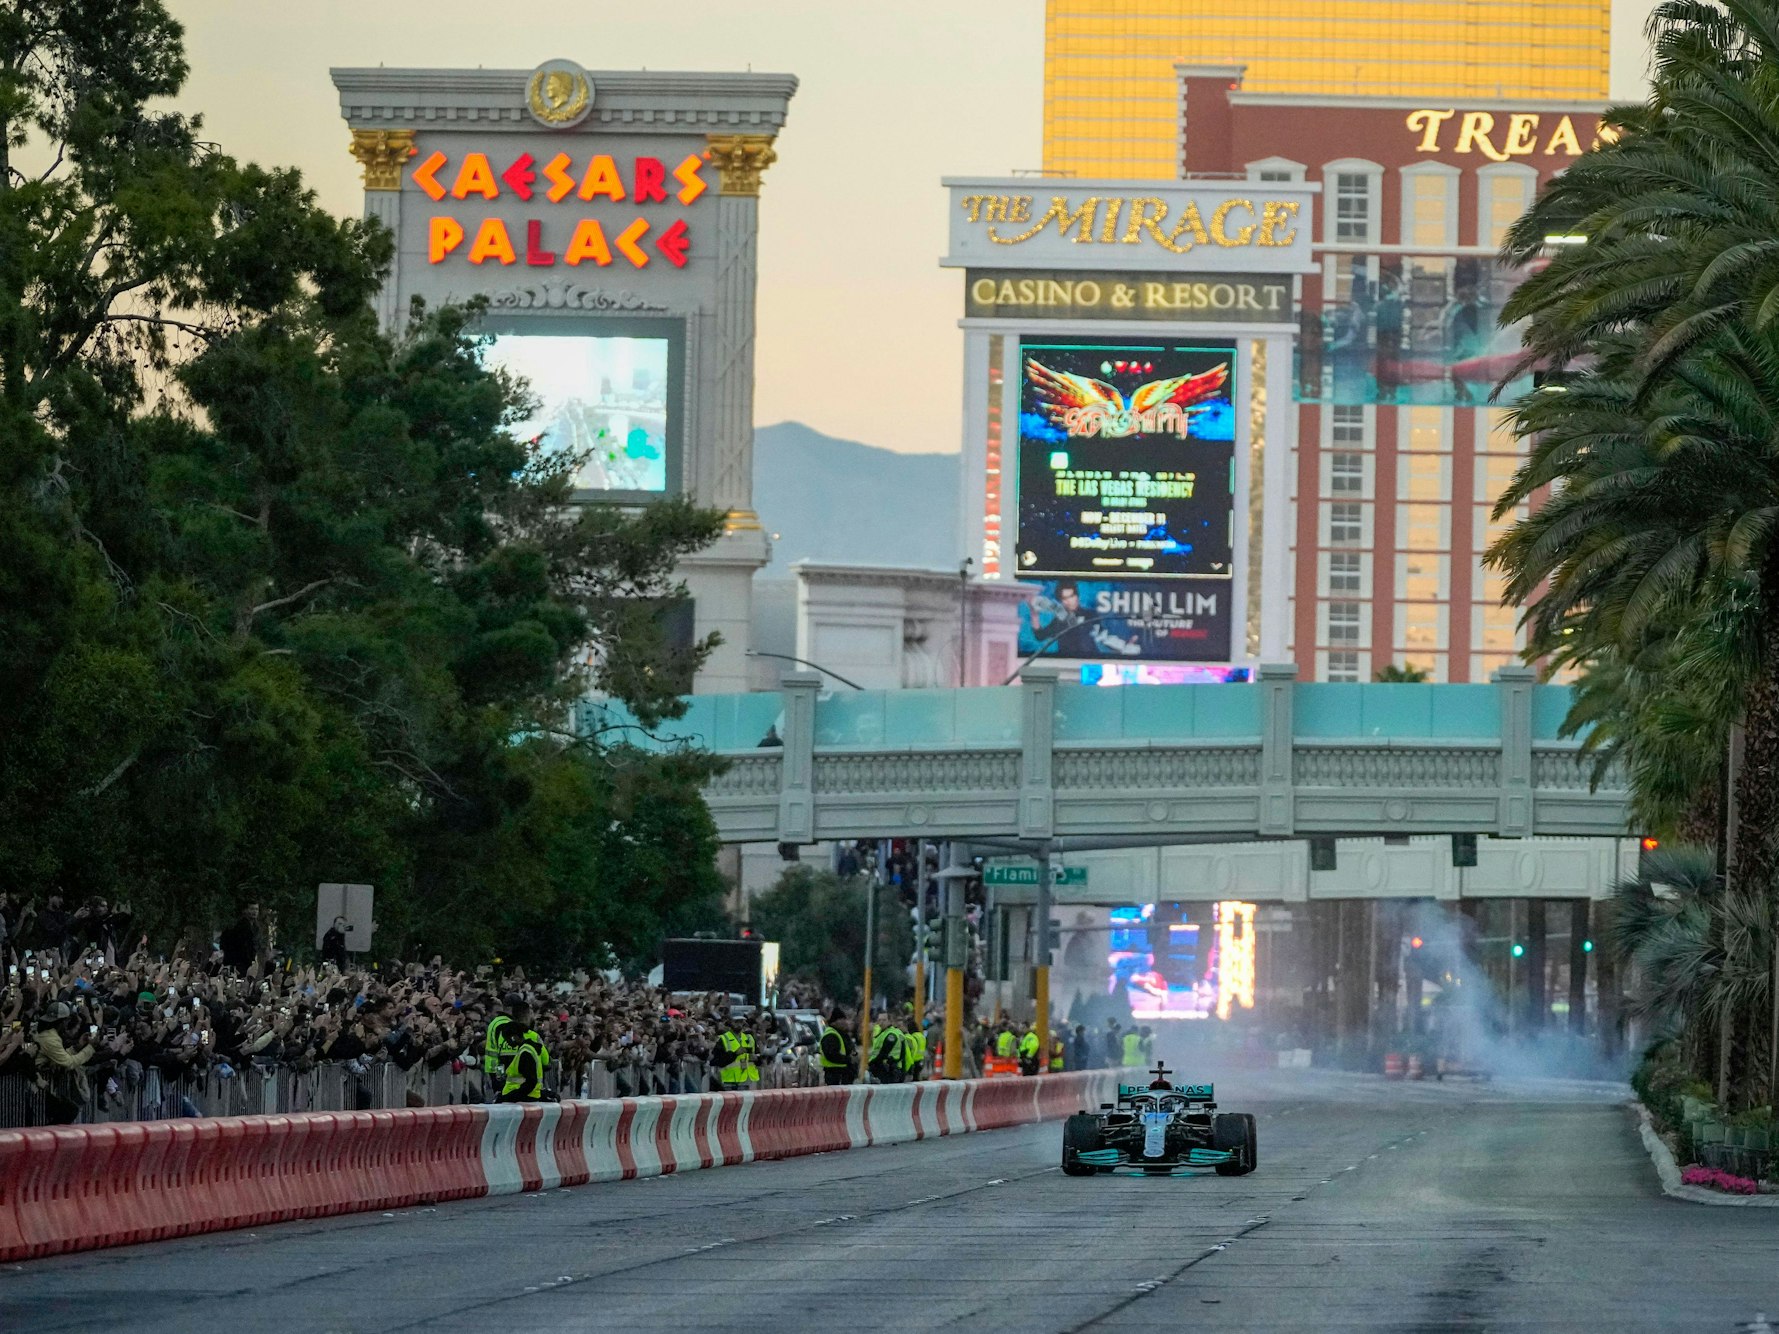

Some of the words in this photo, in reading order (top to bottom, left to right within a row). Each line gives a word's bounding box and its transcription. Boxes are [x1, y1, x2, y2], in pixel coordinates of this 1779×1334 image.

[411, 150, 708, 206] CAESARS
[961, 194, 1033, 223] THE
[988, 195, 1301, 254] MIRAGE
[428, 216, 691, 269] PALACE
[971, 278, 1102, 306] CASINO
[1110, 283, 1136, 309] &
[1144, 281, 1286, 310] RESORT
[1055, 480, 1076, 496] THE
[1078, 480, 1098, 497] LAS
[1100, 480, 1134, 497] VEGAS
[1135, 481, 1194, 498] RESIDENCY
[1096, 591, 1163, 615] SHIN
[1169, 592, 1217, 616] LIM
